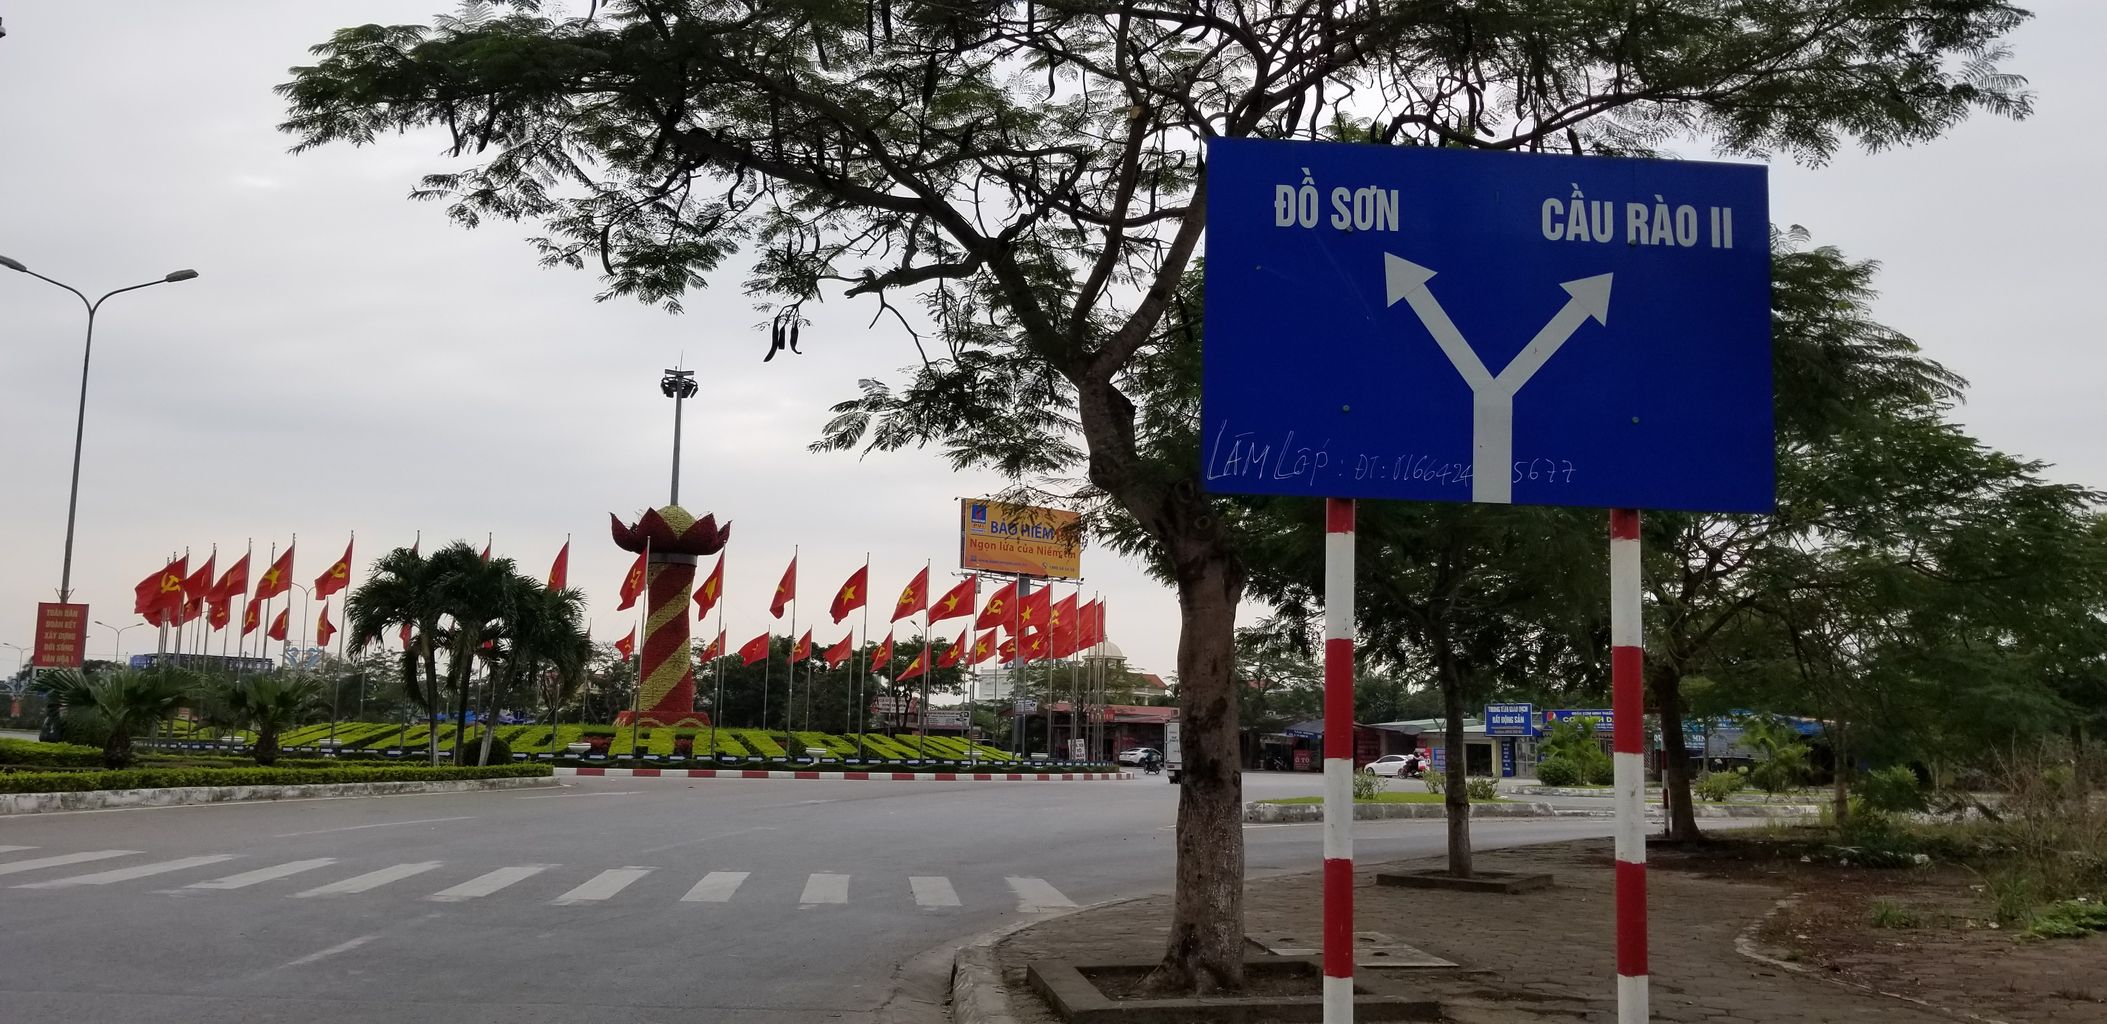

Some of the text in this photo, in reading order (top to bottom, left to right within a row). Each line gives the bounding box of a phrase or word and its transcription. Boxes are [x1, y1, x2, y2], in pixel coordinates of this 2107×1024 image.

[1274, 167, 1399, 232] ĐỒ SƠN
[1541, 182, 1733, 249] CẦU RÀO II
[969, 538, 996, 553] Ngọn
[1017, 543, 1034, 554] của
